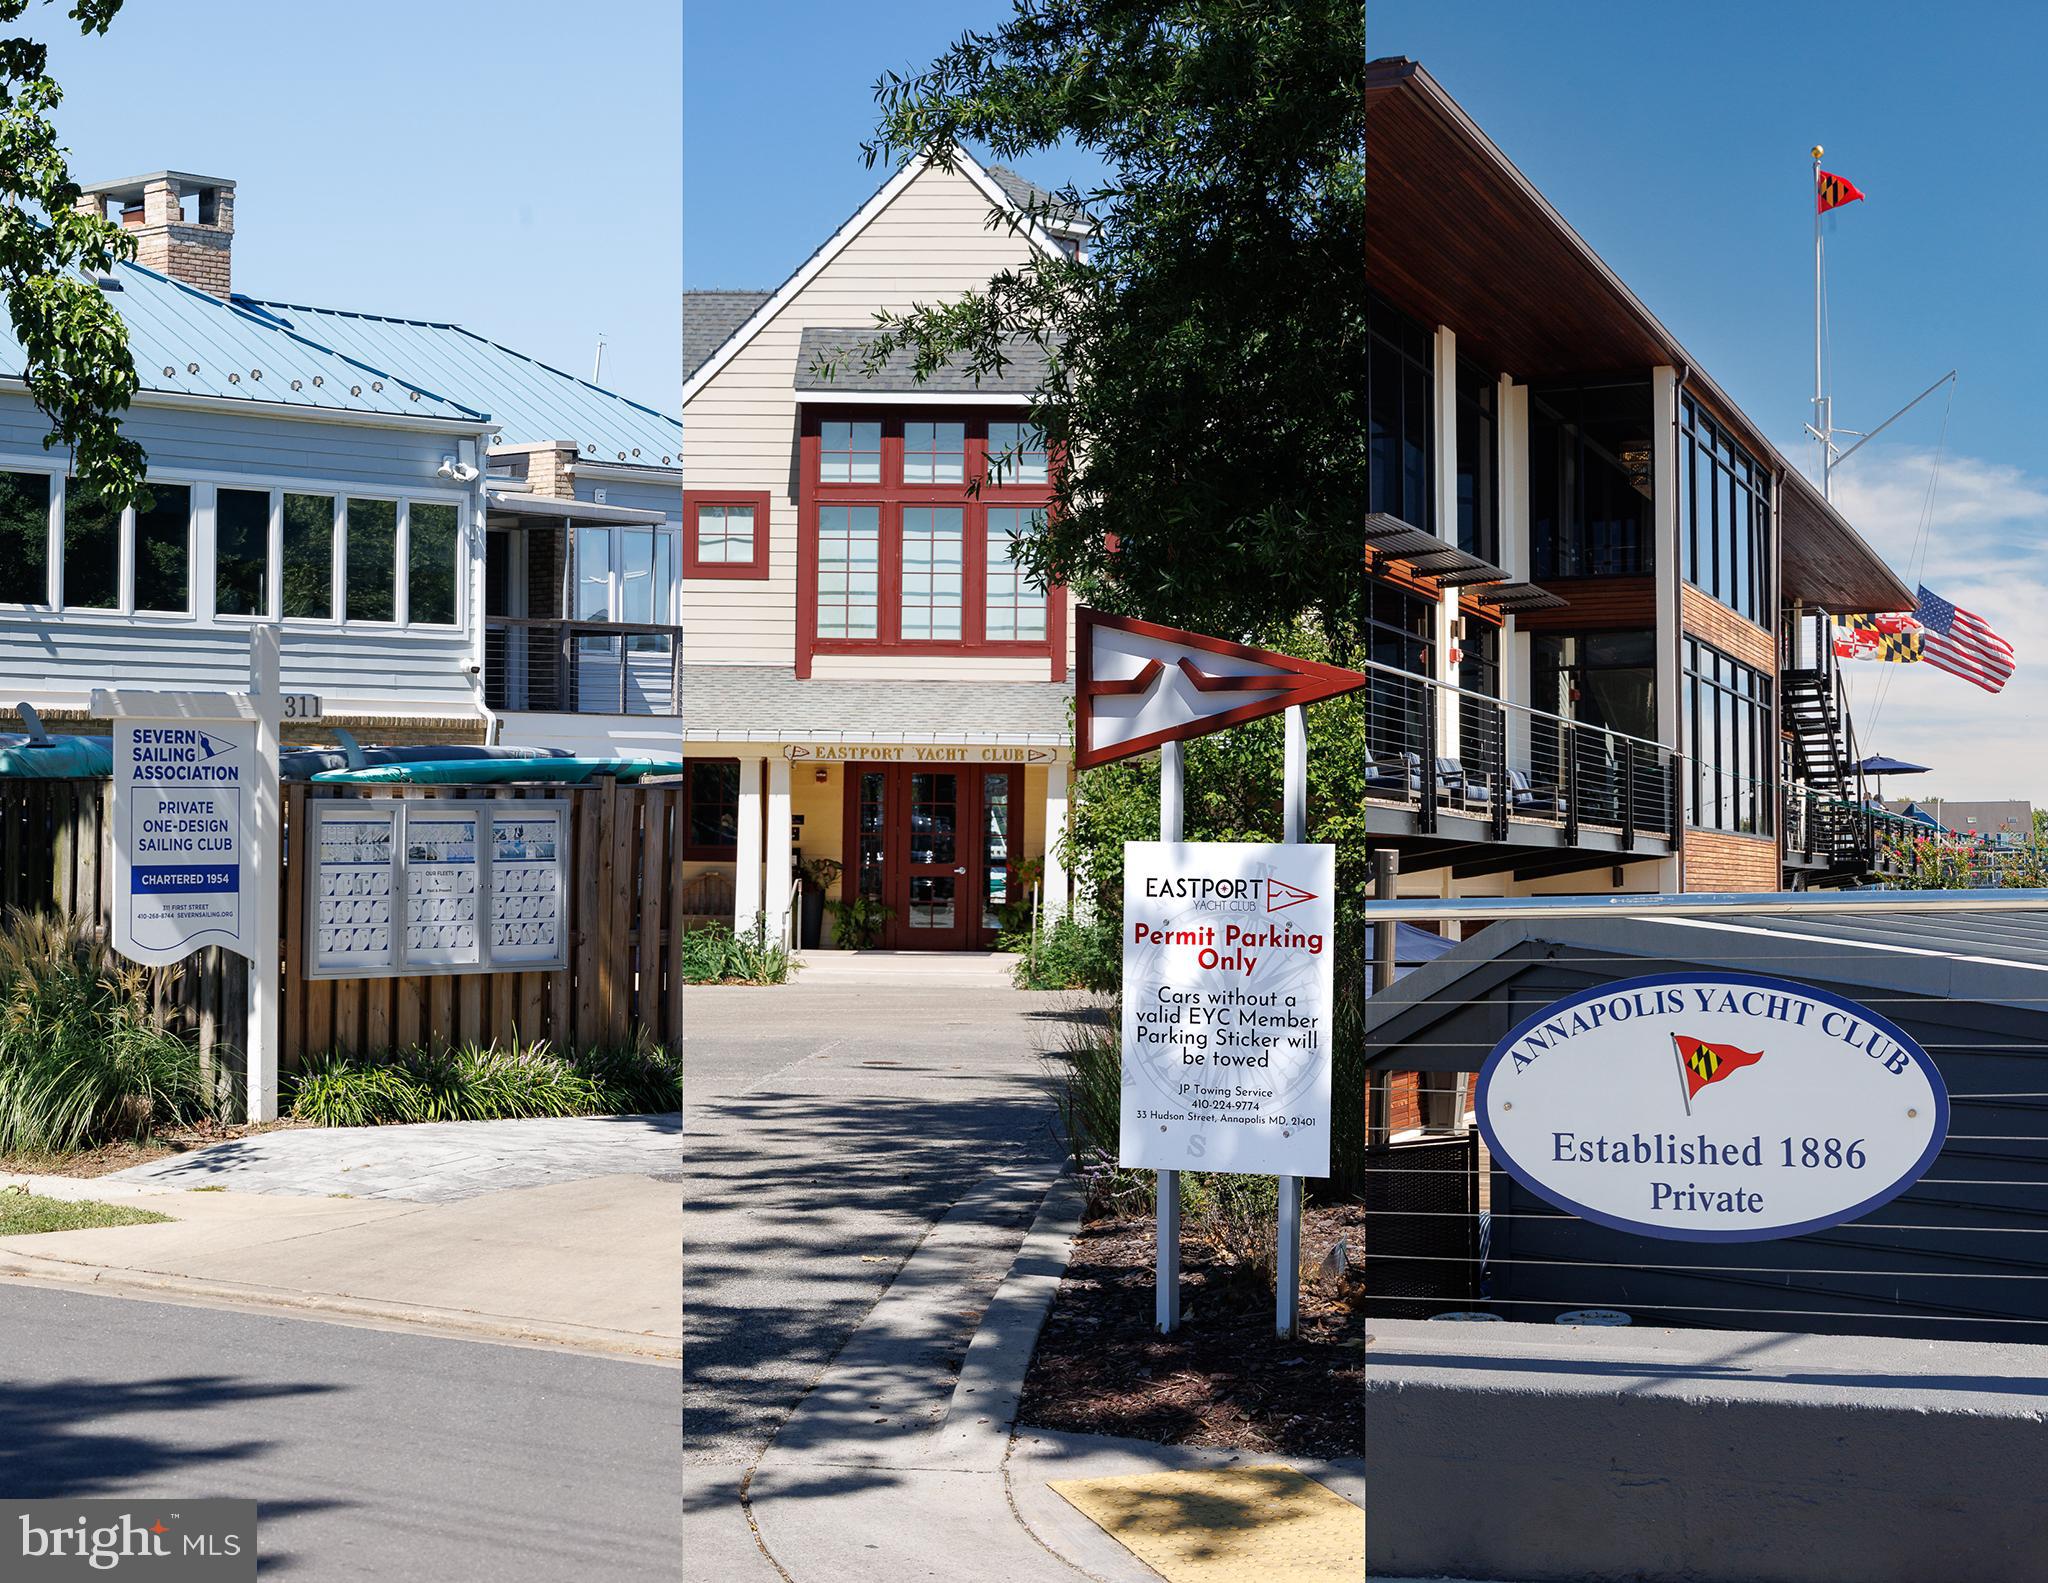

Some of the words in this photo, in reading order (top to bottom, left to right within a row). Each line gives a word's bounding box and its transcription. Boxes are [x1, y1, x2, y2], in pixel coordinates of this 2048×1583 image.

[284, 696, 321, 718] 311
[132, 729, 196, 744] SEVERN
[132, 747, 196, 763] SAILING
[815, 746, 904, 760] EASTPORT
[914, 747, 969, 761] YACHT
[981, 748, 1025, 762] CLUB
[132, 765, 239, 781] ASSOCIATION
[158, 801, 214, 814] PRIVATE
[143, 819, 229, 833] ONE-DESIGN
[138, 838, 194, 851] SAILING
[197, 837, 233, 851] CLUB
[141, 873, 204, 885] CHARTERED
[206, 873, 230, 884] 1954
[1146, 877, 1263, 899] EASTPORT
[1193, 900, 1227, 911] YACHT
[1229, 900, 1257, 912] CLUB
[176, 911, 233, 919] SEVERNSAILING.ORG
[1134, 922, 1215, 946] Permit
[1226, 925, 1323, 955] Parking
[1197, 948, 1258, 976] Only
[1157, 986, 1200, 1005] Cars
[1207, 988, 1278, 1007] without
[1285, 994, 1297, 1007] a
[1136, 1006, 1181, 1024] valid
[1189, 1007, 1231, 1026] EYC
[1239, 1009, 1319, 1028] Member
[1137, 1025, 1208, 1049] Parking
[1216, 1028, 1280, 1048] Sticker
[1287, 1031, 1318, 1049] will
[1509, 988, 1685, 1076] ANNAPOLIS
[1693, 987, 1815, 1028] YACHT
[1821, 1012, 1910, 1077] CLUB
[1182, 1047, 1205, 1066] be
[1213, 1049, 1269, 1068] towed
[1178, 1084, 1190, 1095] JP
[1194, 1084, 1231, 1098] Towing
[1235, 1086, 1273, 1098] Service
[1191, 1099, 1260, 1111] 410-224-9774
[1136, 1110, 1147, 1119] 33
[1150, 1110, 1184, 1121] Hudson
[1187, 1112, 1217, 1123] Street,
[1220, 1114, 1266, 1126] Annapolis
[1269, 1115, 1288, 1127] MD,
[1291, 1117, 1316, 1127] 21401
[1551, 1132, 1763, 1168] Established
[1780, 1137, 1867, 1171] 1886
[1650, 1182, 1764, 1214] Private
